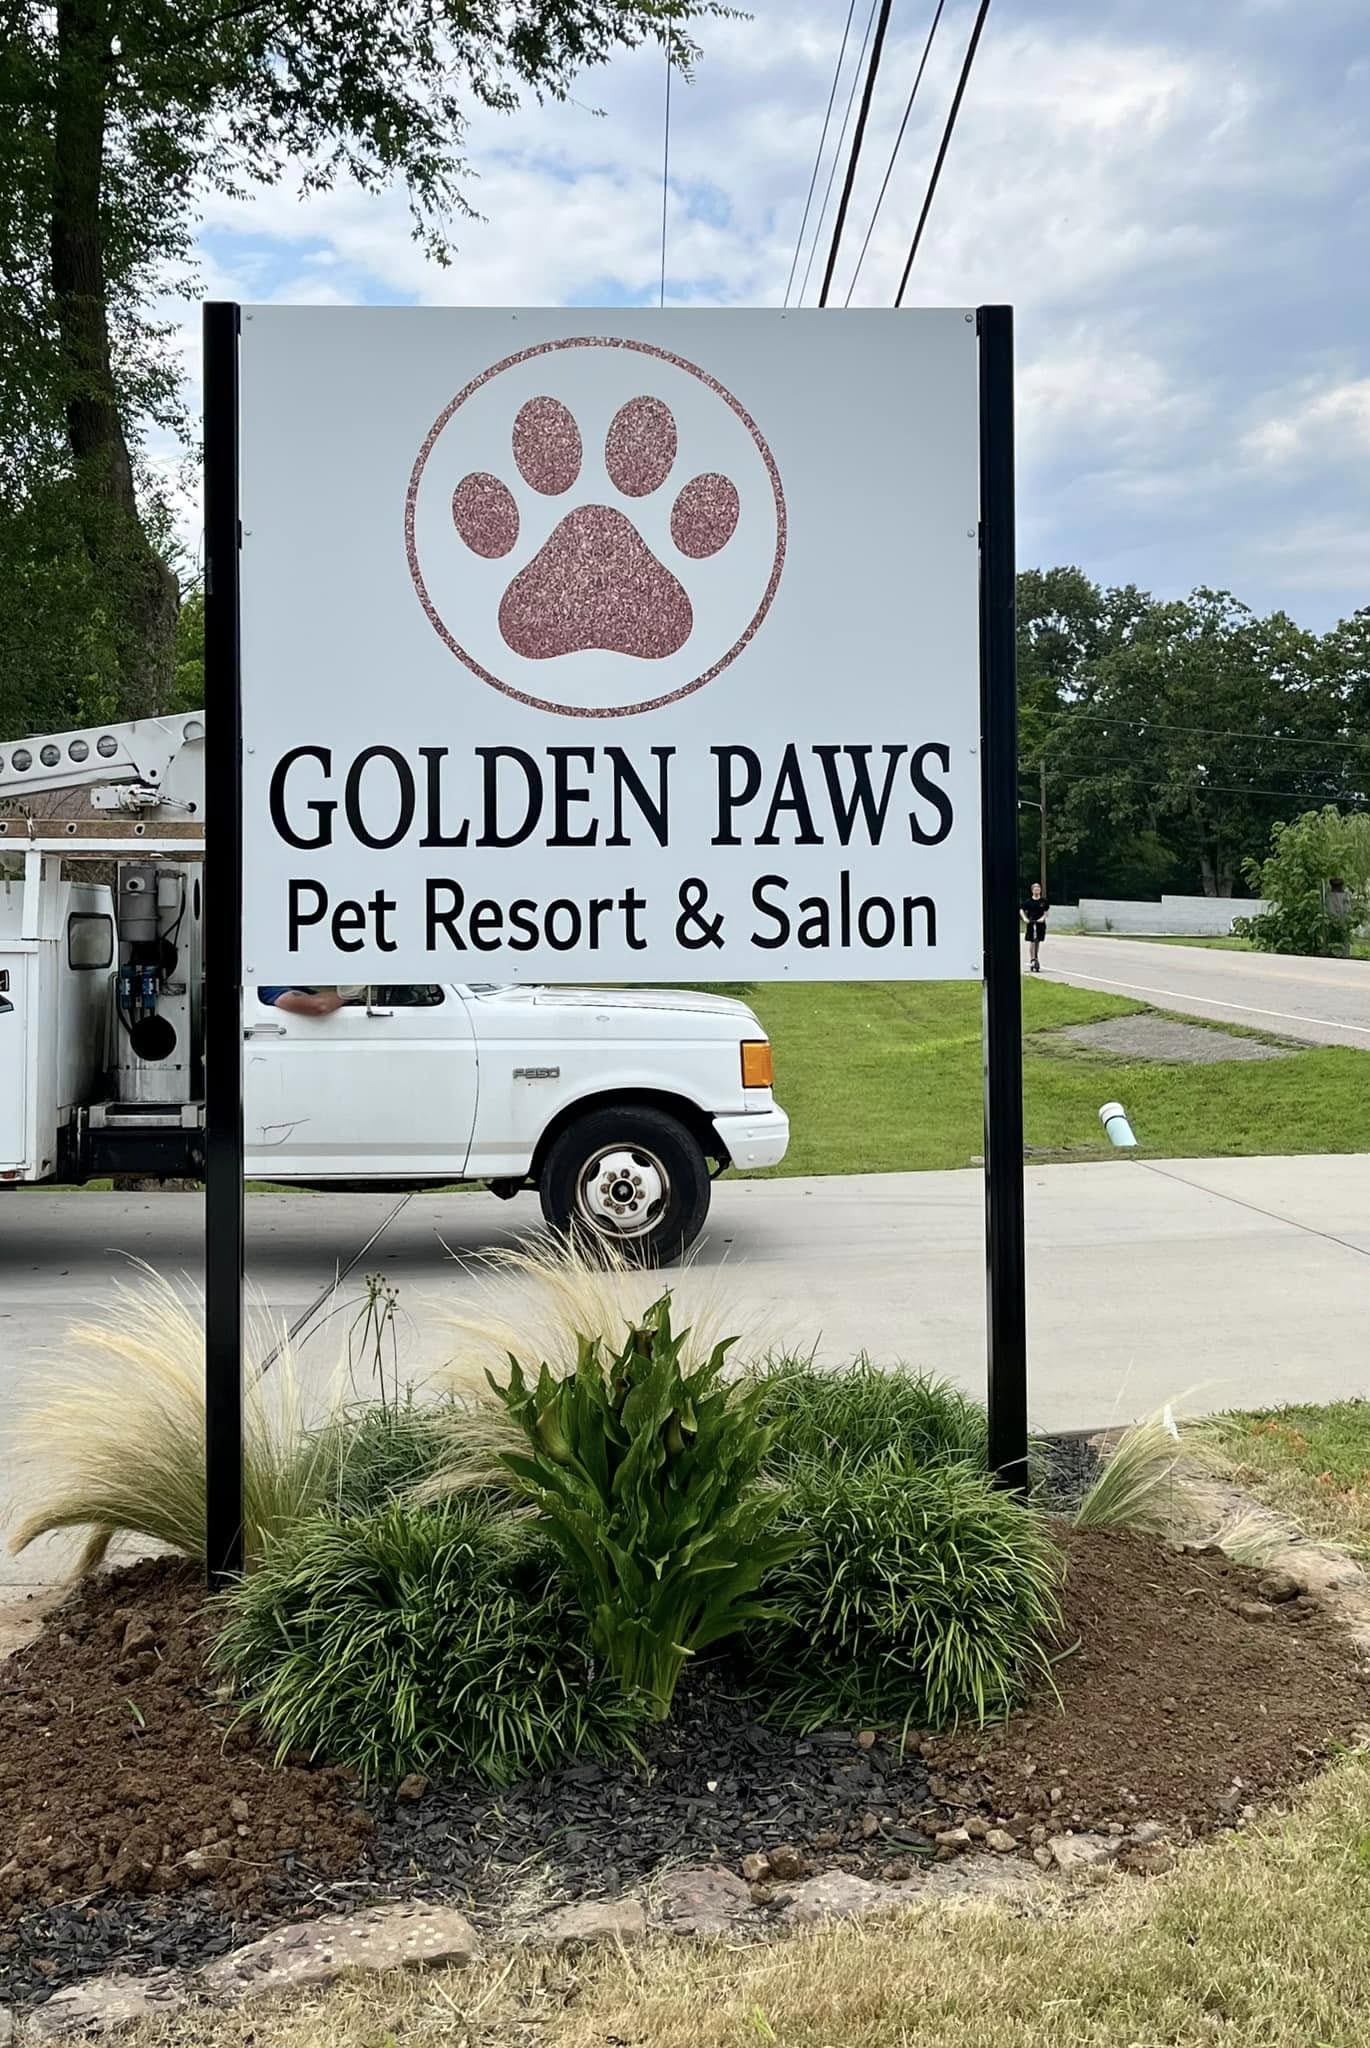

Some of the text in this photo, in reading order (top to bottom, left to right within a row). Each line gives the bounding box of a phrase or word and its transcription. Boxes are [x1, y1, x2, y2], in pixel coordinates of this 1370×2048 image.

[270, 743, 953, 849] GOLDEN PAWS
[289, 871, 936, 952] Pet Resort & Salon
